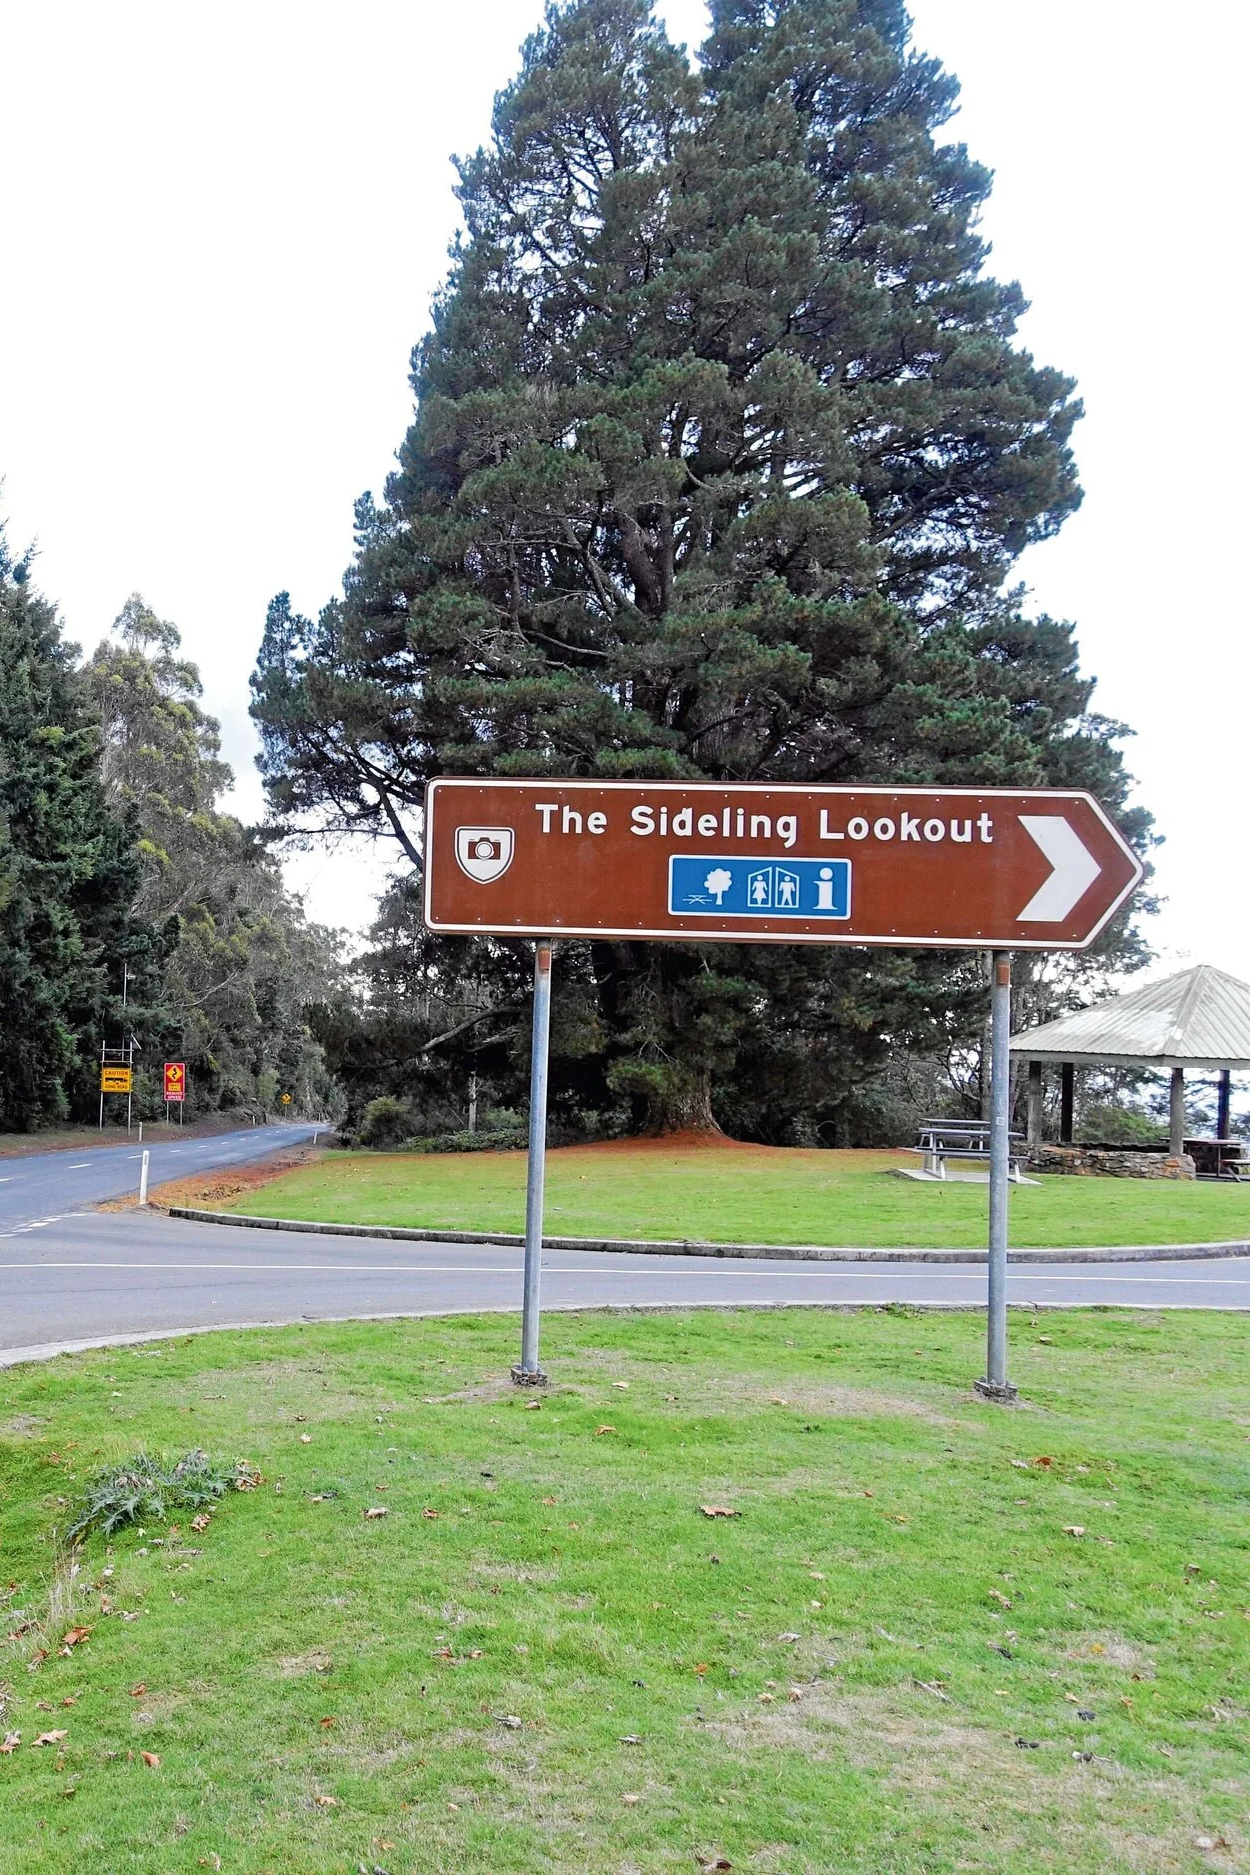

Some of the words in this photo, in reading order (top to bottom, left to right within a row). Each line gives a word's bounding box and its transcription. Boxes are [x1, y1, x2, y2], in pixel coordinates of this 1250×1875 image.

[535, 804, 607, 835] The
[630, 805, 797, 848] Sideling
[820, 809, 994, 843] Lookout
